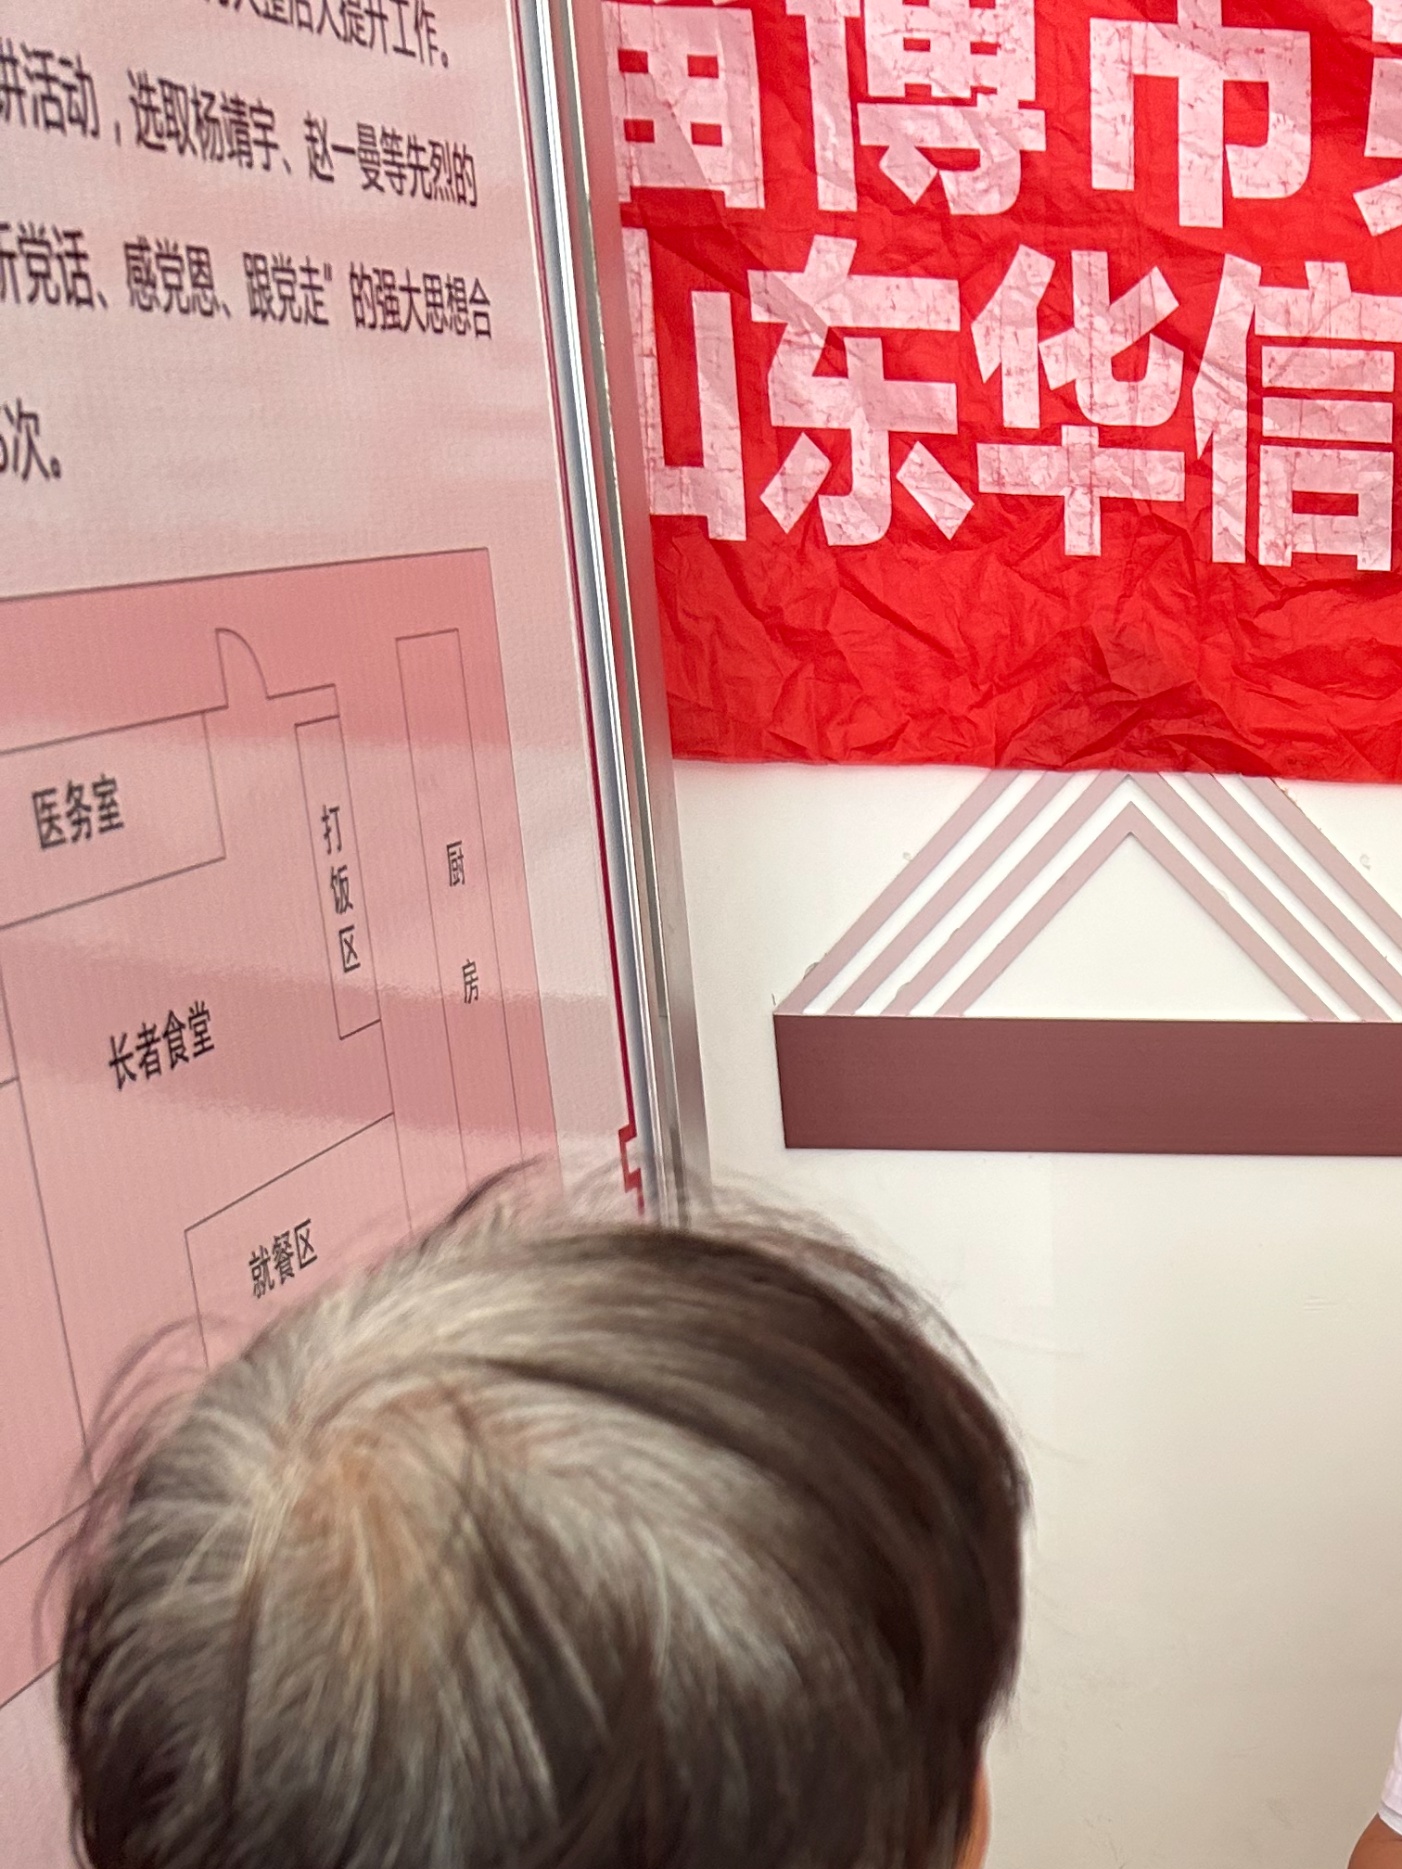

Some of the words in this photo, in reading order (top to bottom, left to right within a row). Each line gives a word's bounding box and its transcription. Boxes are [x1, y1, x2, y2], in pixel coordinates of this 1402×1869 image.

[31, 773, 125, 851] 医务室
[320, 804, 362, 974] 打饭区
[107, 1001, 215, 1090] 长者食堂
[249, 1219, 319, 1300] 就餐区
